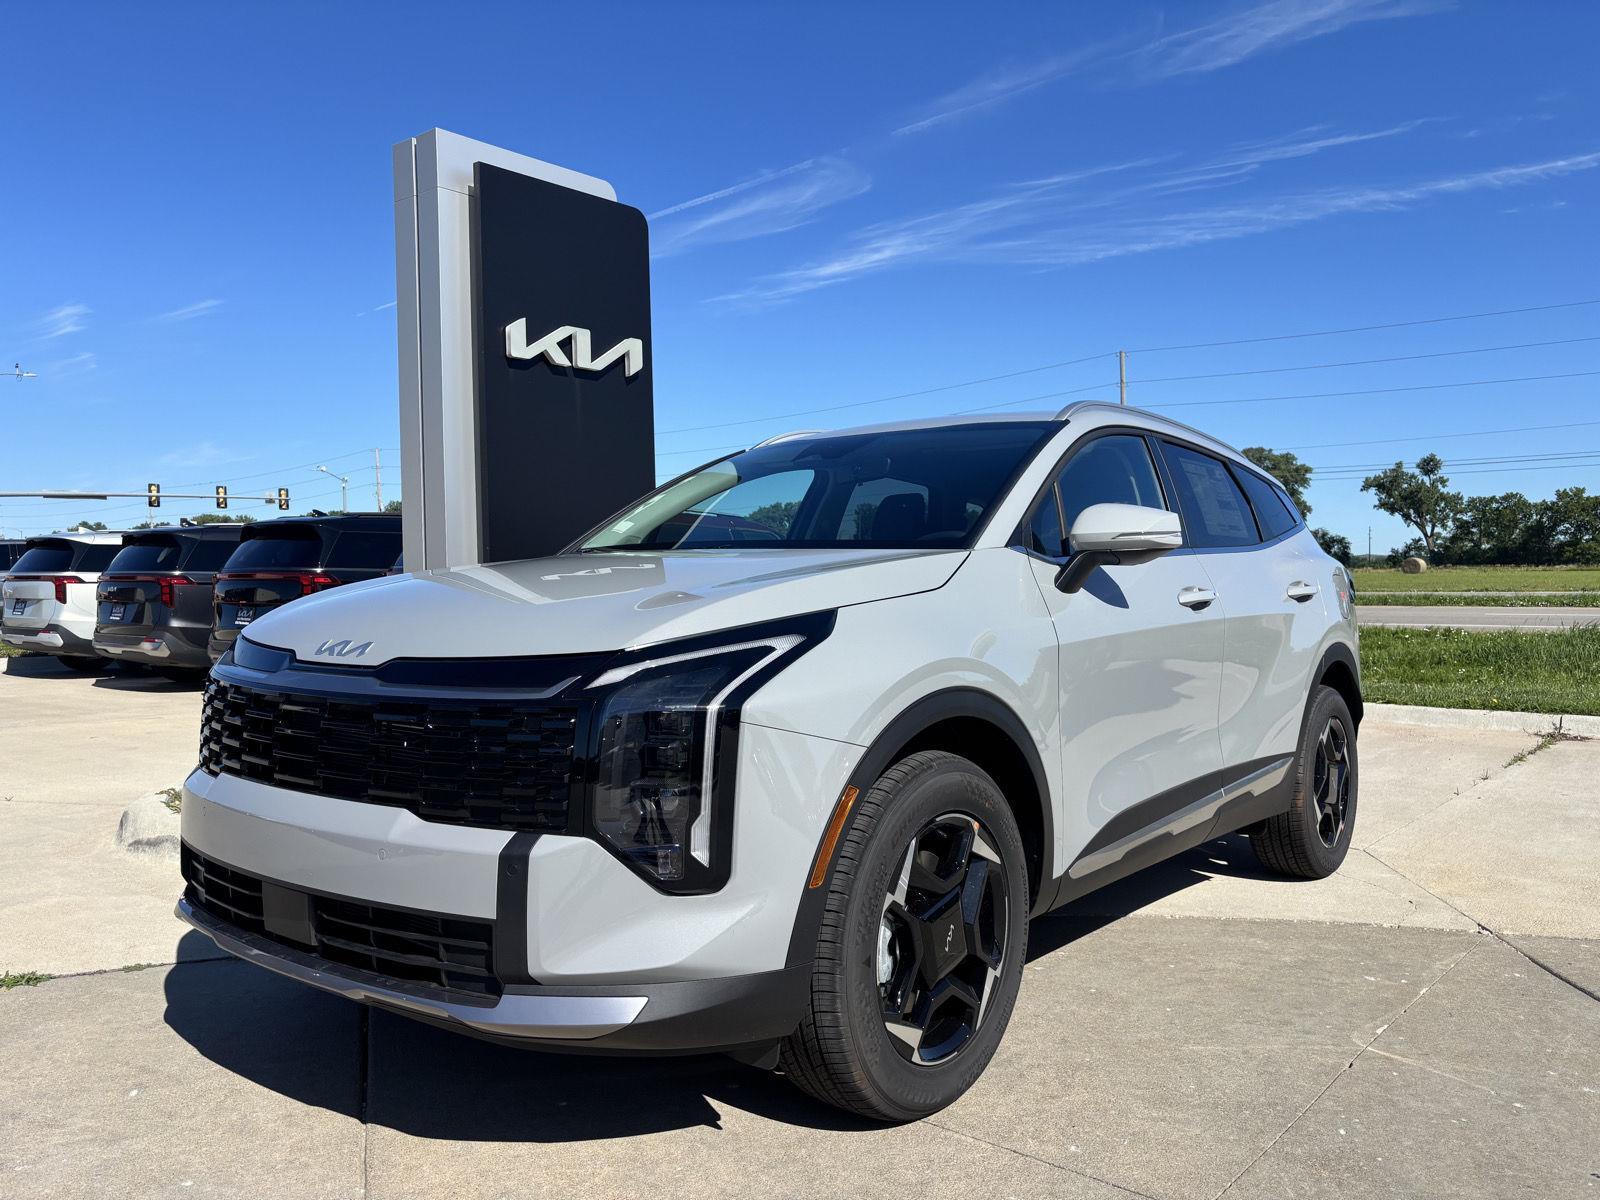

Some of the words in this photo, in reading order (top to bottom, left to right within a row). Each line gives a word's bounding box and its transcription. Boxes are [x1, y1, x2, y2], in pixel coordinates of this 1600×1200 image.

[505, 317, 643, 378] KIA
[314, 639, 375, 658] KIA
[944, 924, 955, 953] KIA
